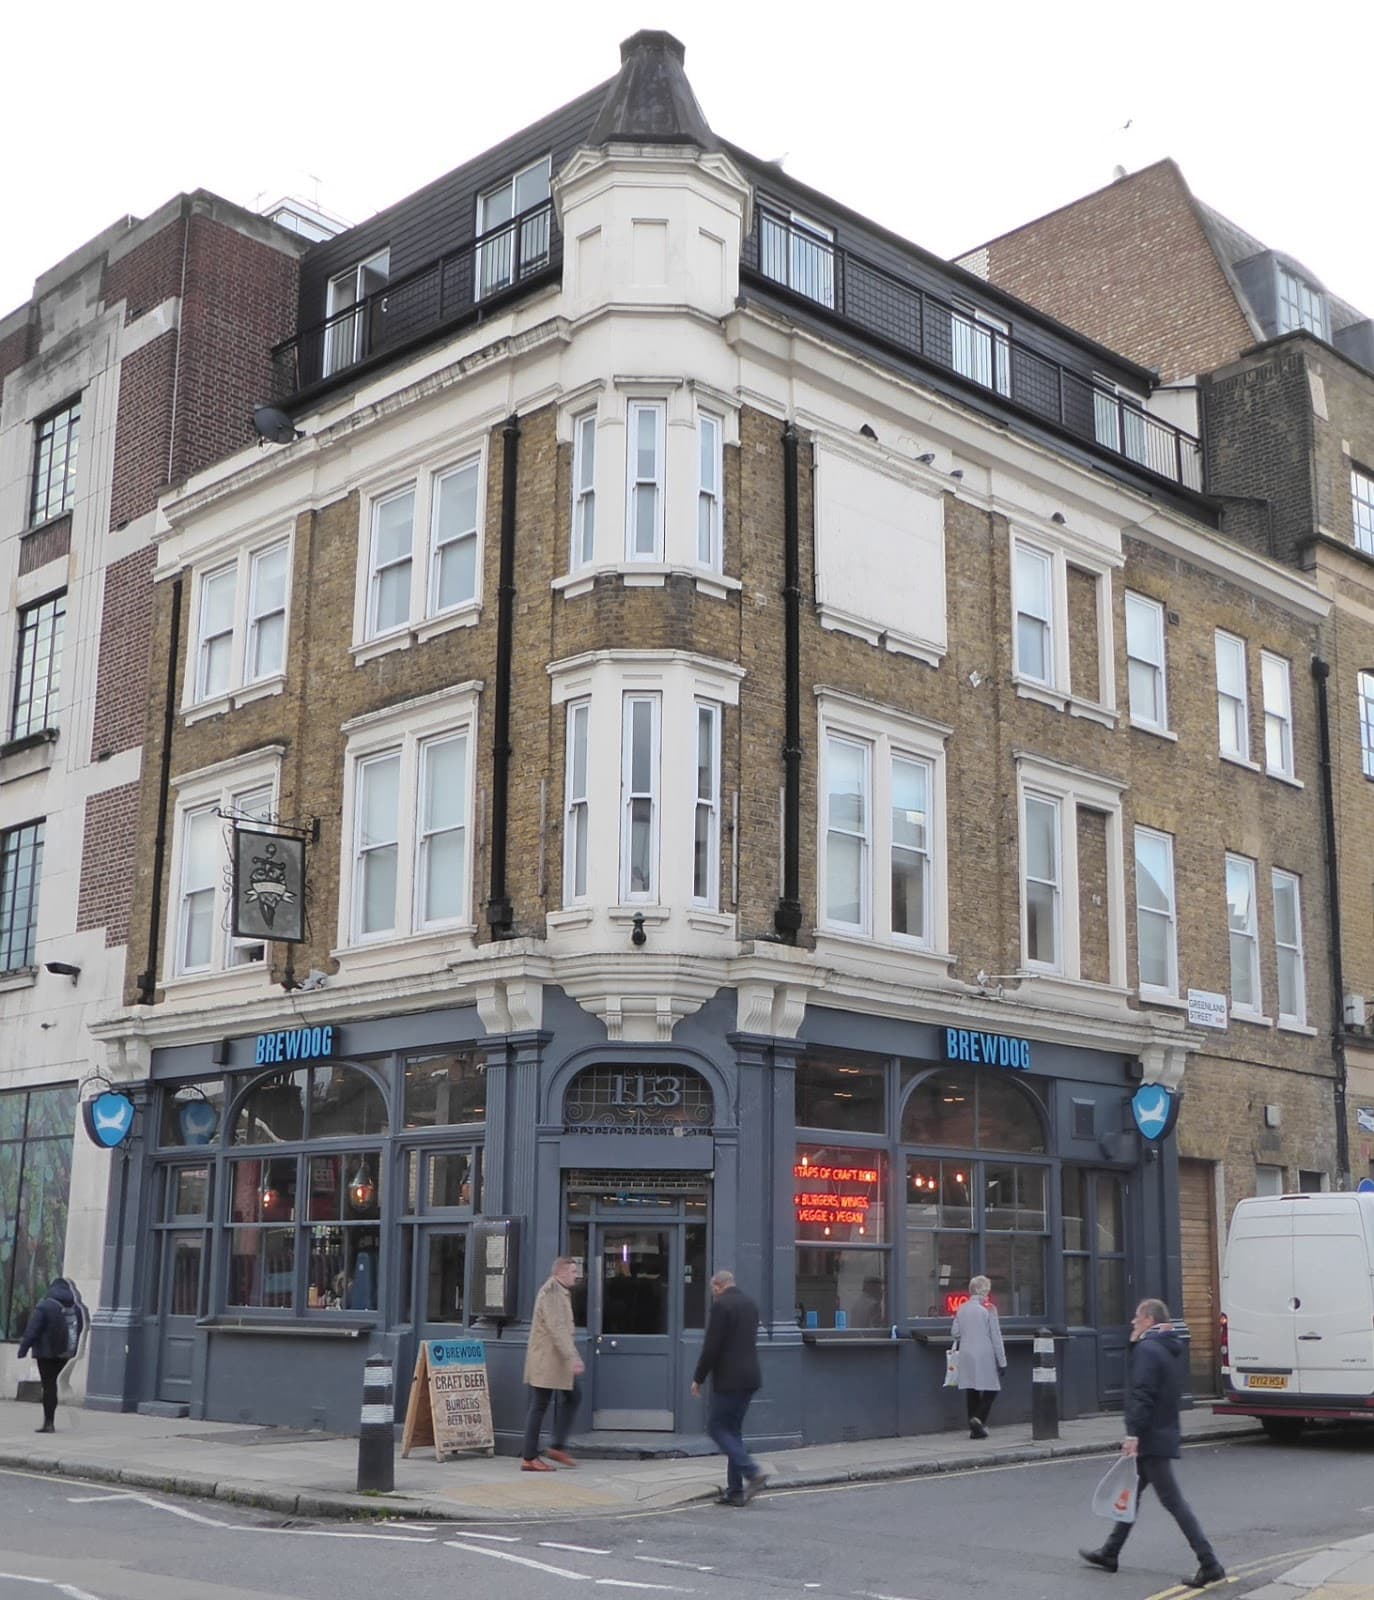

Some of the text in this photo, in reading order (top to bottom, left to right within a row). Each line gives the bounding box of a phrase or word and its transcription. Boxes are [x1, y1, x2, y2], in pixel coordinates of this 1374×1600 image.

[1189, 999, 1225, 1013] GREENLAND
[1190, 1011, 1212, 1022] STREET
[255, 1025, 333, 1064] BREWDOG
[946, 1027, 1030, 1069] BREWDOG
[612, 1074, 681, 1107] 113
[798, 1166, 819, 1178] TAPS
[820, 1167, 832, 1179] OF
[832, 1169, 857, 1181] CRAFT
[445, 1345, 482, 1359] BREWDOG
[435, 1374, 486, 1390] CRAFT BEER
[446, 1398, 480, 1411] BURGERS
[447, 1415, 463, 1426] BEER
[464, 1414, 473, 1425] TO
